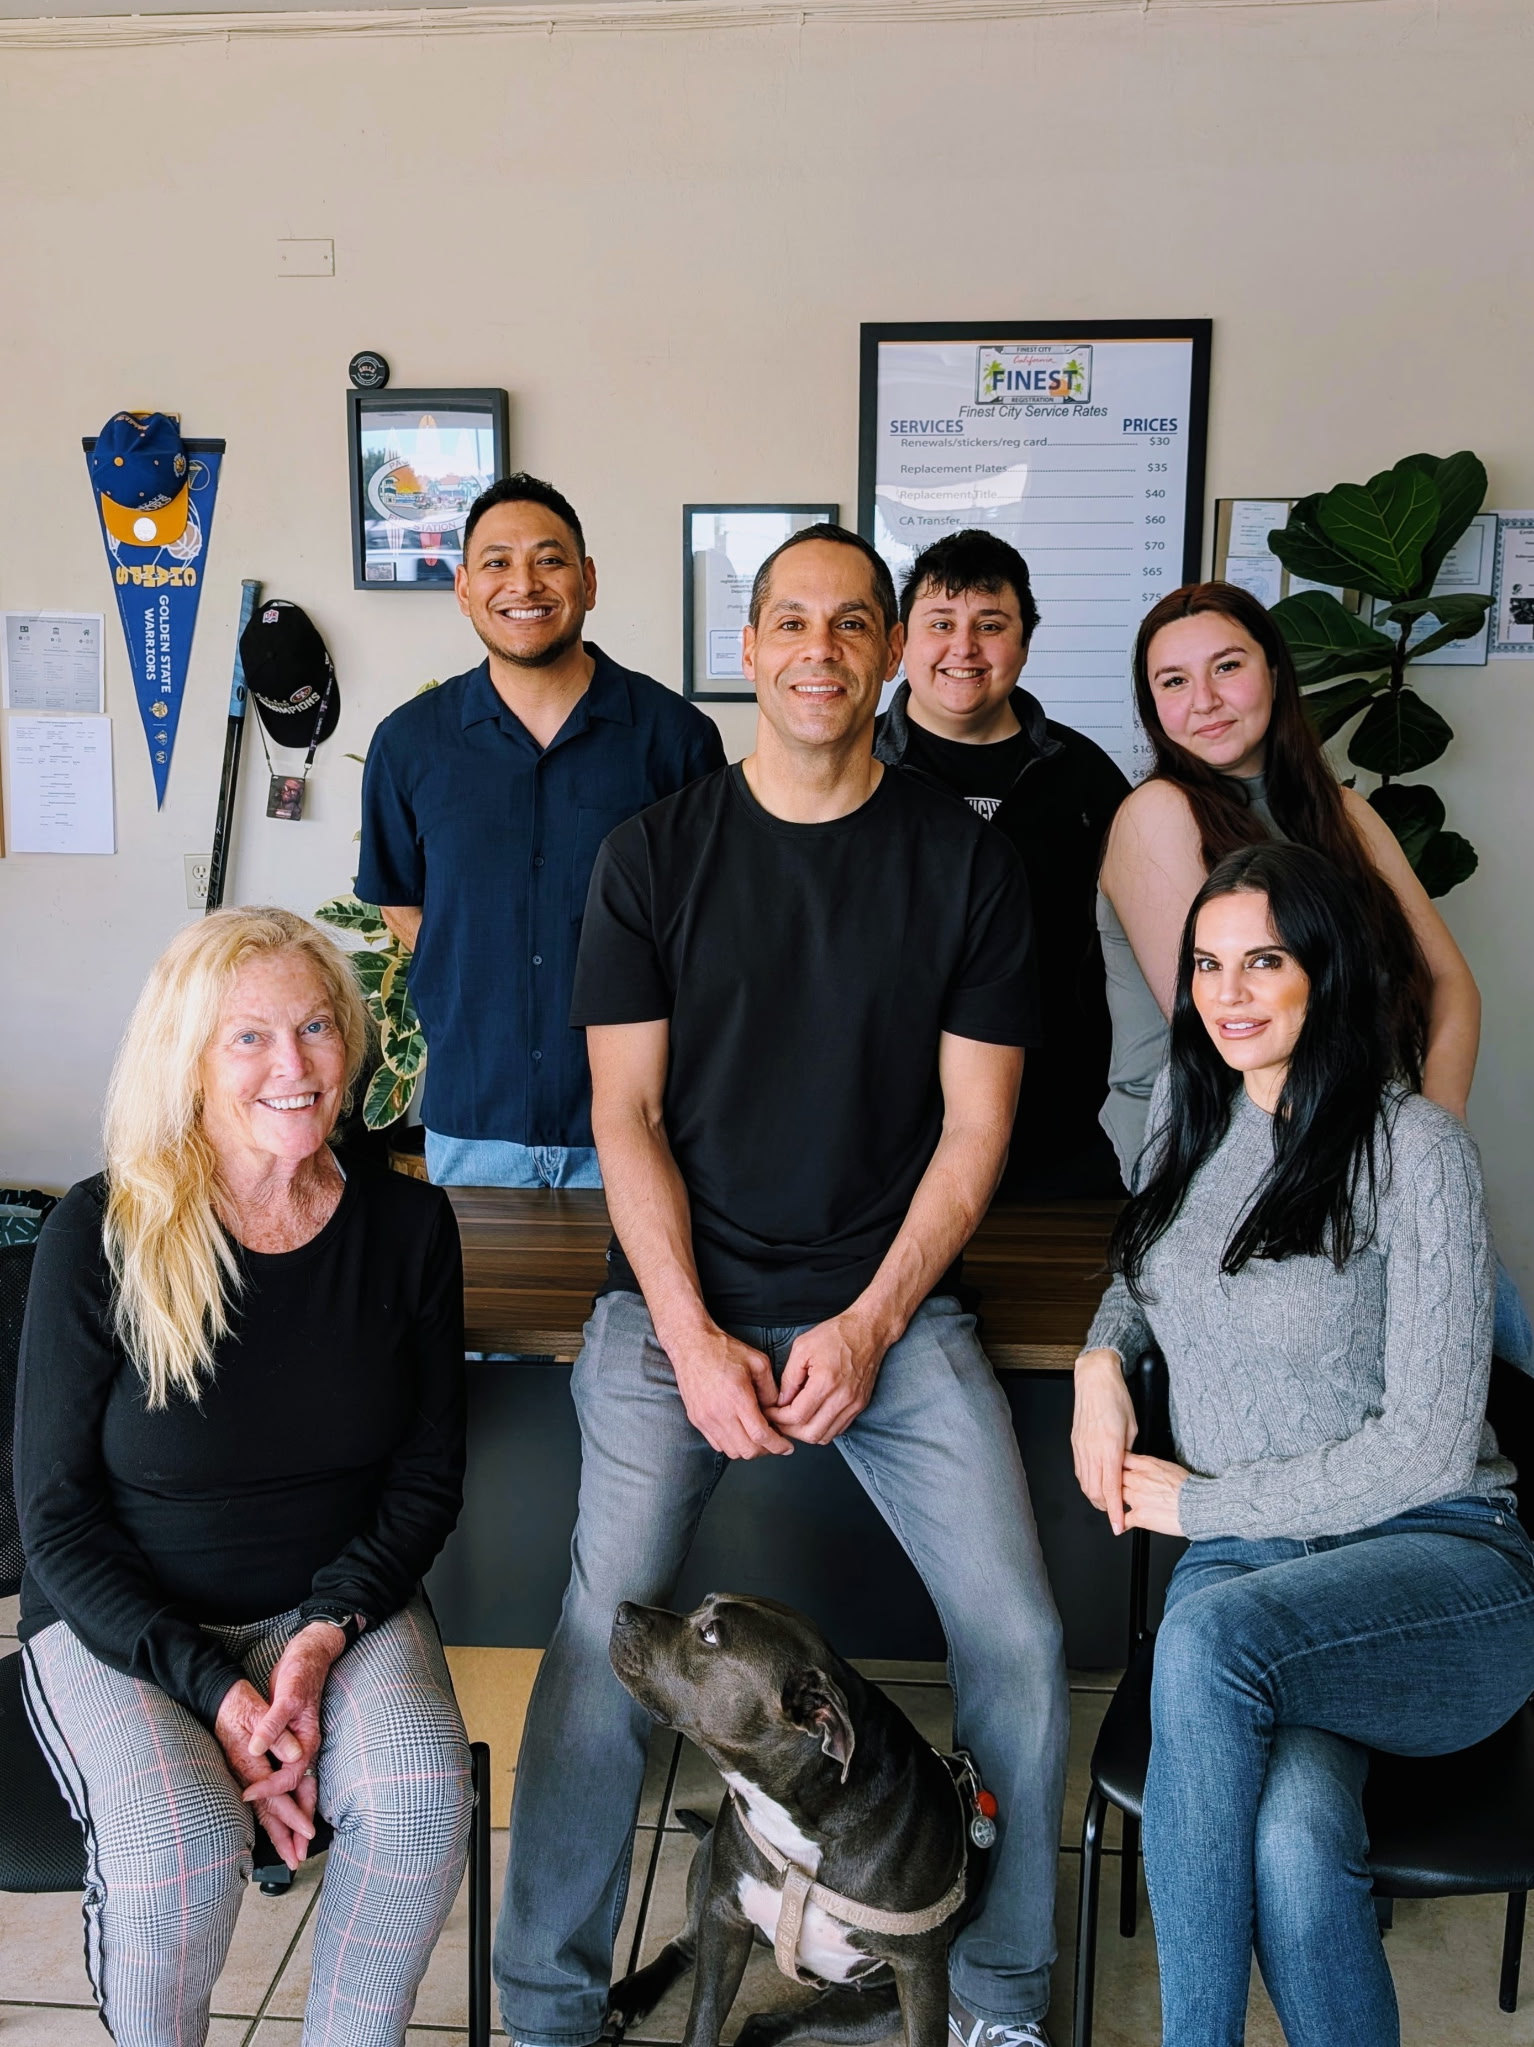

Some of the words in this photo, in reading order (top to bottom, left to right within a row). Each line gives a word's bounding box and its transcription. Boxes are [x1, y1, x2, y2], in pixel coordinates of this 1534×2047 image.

[1013, 355, 1057, 366] California
[992, 370, 1078, 390] FINEST
[958, 405, 995, 418] Finest
[999, 405, 1022, 420] City
[1025, 405, 1069, 417] Service
[1073, 405, 1108, 417] Rates
[890, 419, 964, 433] SERVICES
[1122, 418, 1178, 432] PRICES
[901, 437, 1021, 448] Renewals/stickers/reg
[1023, 436, 1048, 447] card
[1149, 437, 1170, 446] $30
[900, 464, 972, 475] Replacement
[975, 464, 1008, 473] Plates
[1147, 463, 1168, 472] $35
[900, 490, 972, 501] Replacement
[974, 490, 998, 499] Title
[1145, 489, 1166, 499] $40
[899, 516, 915, 526] CA
[917, 516, 960, 526] Transfer
[1145, 515, 1166, 525] $60
[414, 522, 456, 532] STATION
[1144, 541, 1165, 551] $70
[115, 564, 197, 588] CHAMPS
[1142, 567, 1163, 576] $65
[1142, 593, 1161, 602] $75
[159, 594, 171, 653] GOLDEN
[144, 608, 157, 681] WARRIORS
[161, 653, 172, 694] STATE
